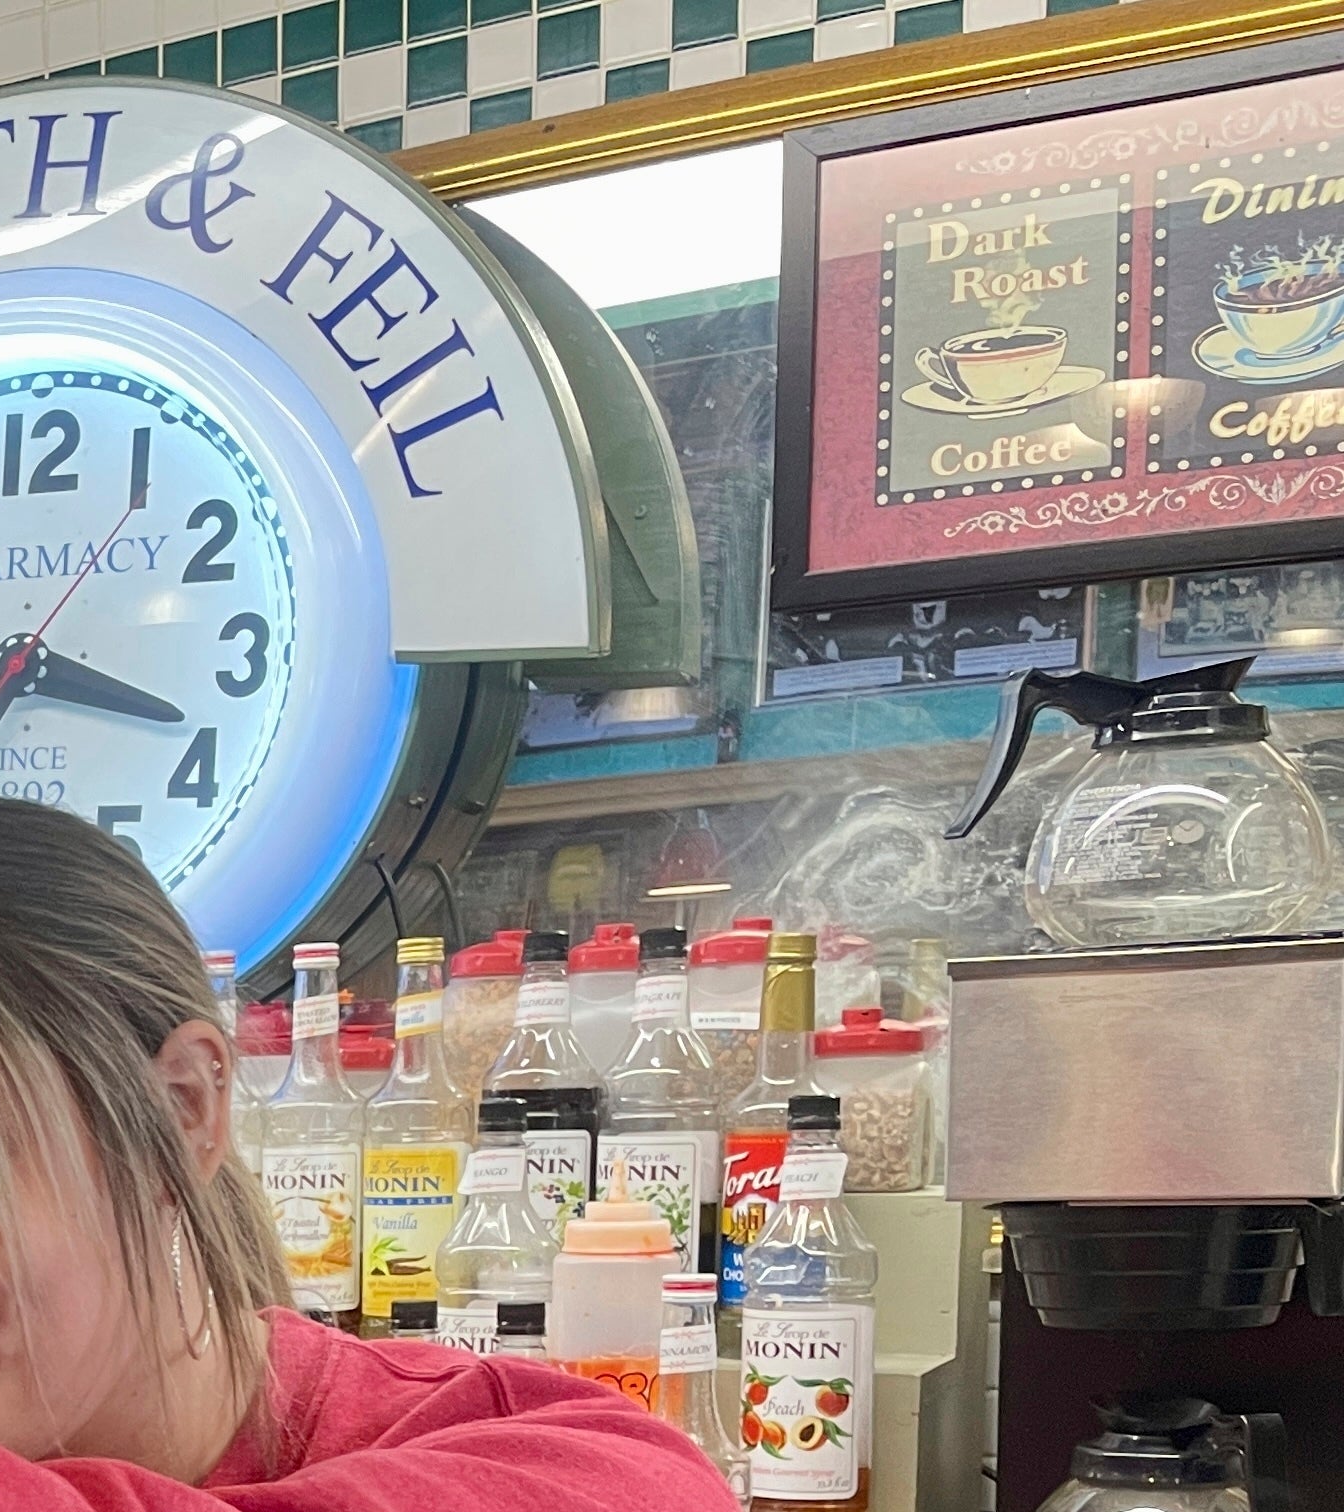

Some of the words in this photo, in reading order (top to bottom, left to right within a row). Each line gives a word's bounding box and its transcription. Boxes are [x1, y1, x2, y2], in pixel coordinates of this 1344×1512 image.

[925, 213, 1053, 265] Dark
[950, 255, 1090, 304] Roast
[146, 131, 256, 254] &
[257, 189, 505, 500] FEIL
[2, 409, 81, 497] 12
[130, 427, 151, 510] 1
[931, 435, 1074, 477] Coffee
[181, 498, 238, 584] 2
[215, 611, 271, 699] 3
[167, 726, 219, 809] 4
[267, 1173, 346, 1189] MONIN
[527, 1159, 576, 1175] NIN
[598, 1165, 681, 1182] MNIN
[373, 1212, 418, 1230] Vanilla
[746, 1338, 841, 1360] MONIN
[813, 1330, 830, 1340] de
[763, 1396, 806, 1417] Peach
